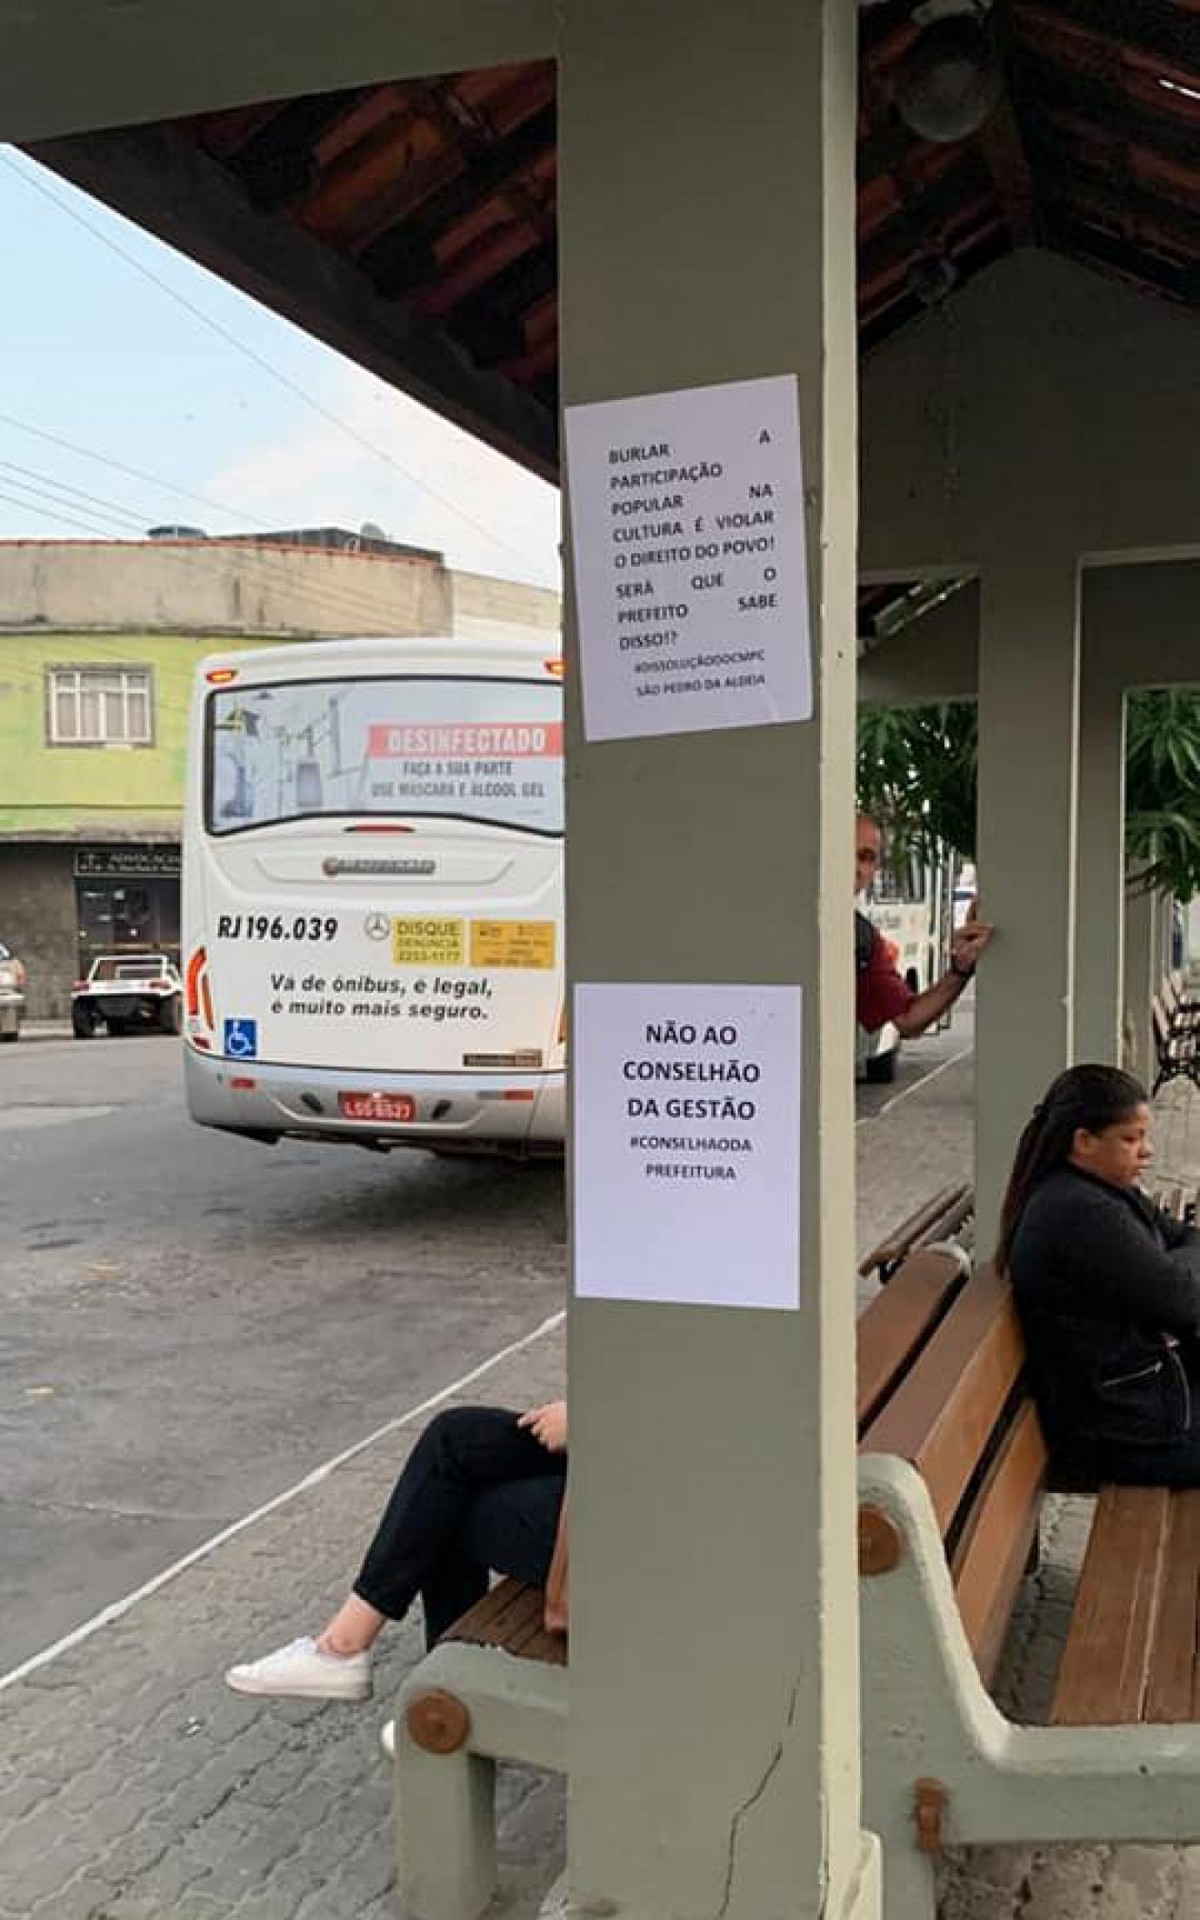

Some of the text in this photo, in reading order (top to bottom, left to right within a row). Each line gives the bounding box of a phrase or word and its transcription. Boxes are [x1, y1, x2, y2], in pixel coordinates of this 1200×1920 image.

[609, 429, 771, 464] BURLAR A
[610, 461, 723, 490] PARTICIPAÇÃO
[611, 484, 774, 516] POPULAR NA
[613, 510, 774, 543] CULTURA É VIOLAR
[615, 536, 775, 569] O DIREITO DO POVO!
[691, 572, 725, 590] QUE
[764, 567, 777, 581] O
[617, 593, 777, 624] PREFEITO SABE
[619, 631, 678, 651] DISSO!?
[636, 681, 662, 697] SÃO
[388, 726, 546, 753] DESINFECTADO
[475, 760, 513, 775] PARTE
[217, 915, 339, 941] RJ 196.039
[397, 922, 461, 936] DISQUE
[301, 974, 326, 992] de
[432, 977, 492, 1000] legal,
[288, 999, 345, 1015] muito
[352, 999, 401, 1017] mais
[408, 1004, 489, 1022] seguro.
[645, 1020, 737, 1045] NÃO AO
[623, 1060, 760, 1083] CONSELHÃO
[628, 1095, 755, 1120] DA GESTÃO
[646, 1164, 737, 1180] PREFEITURA
